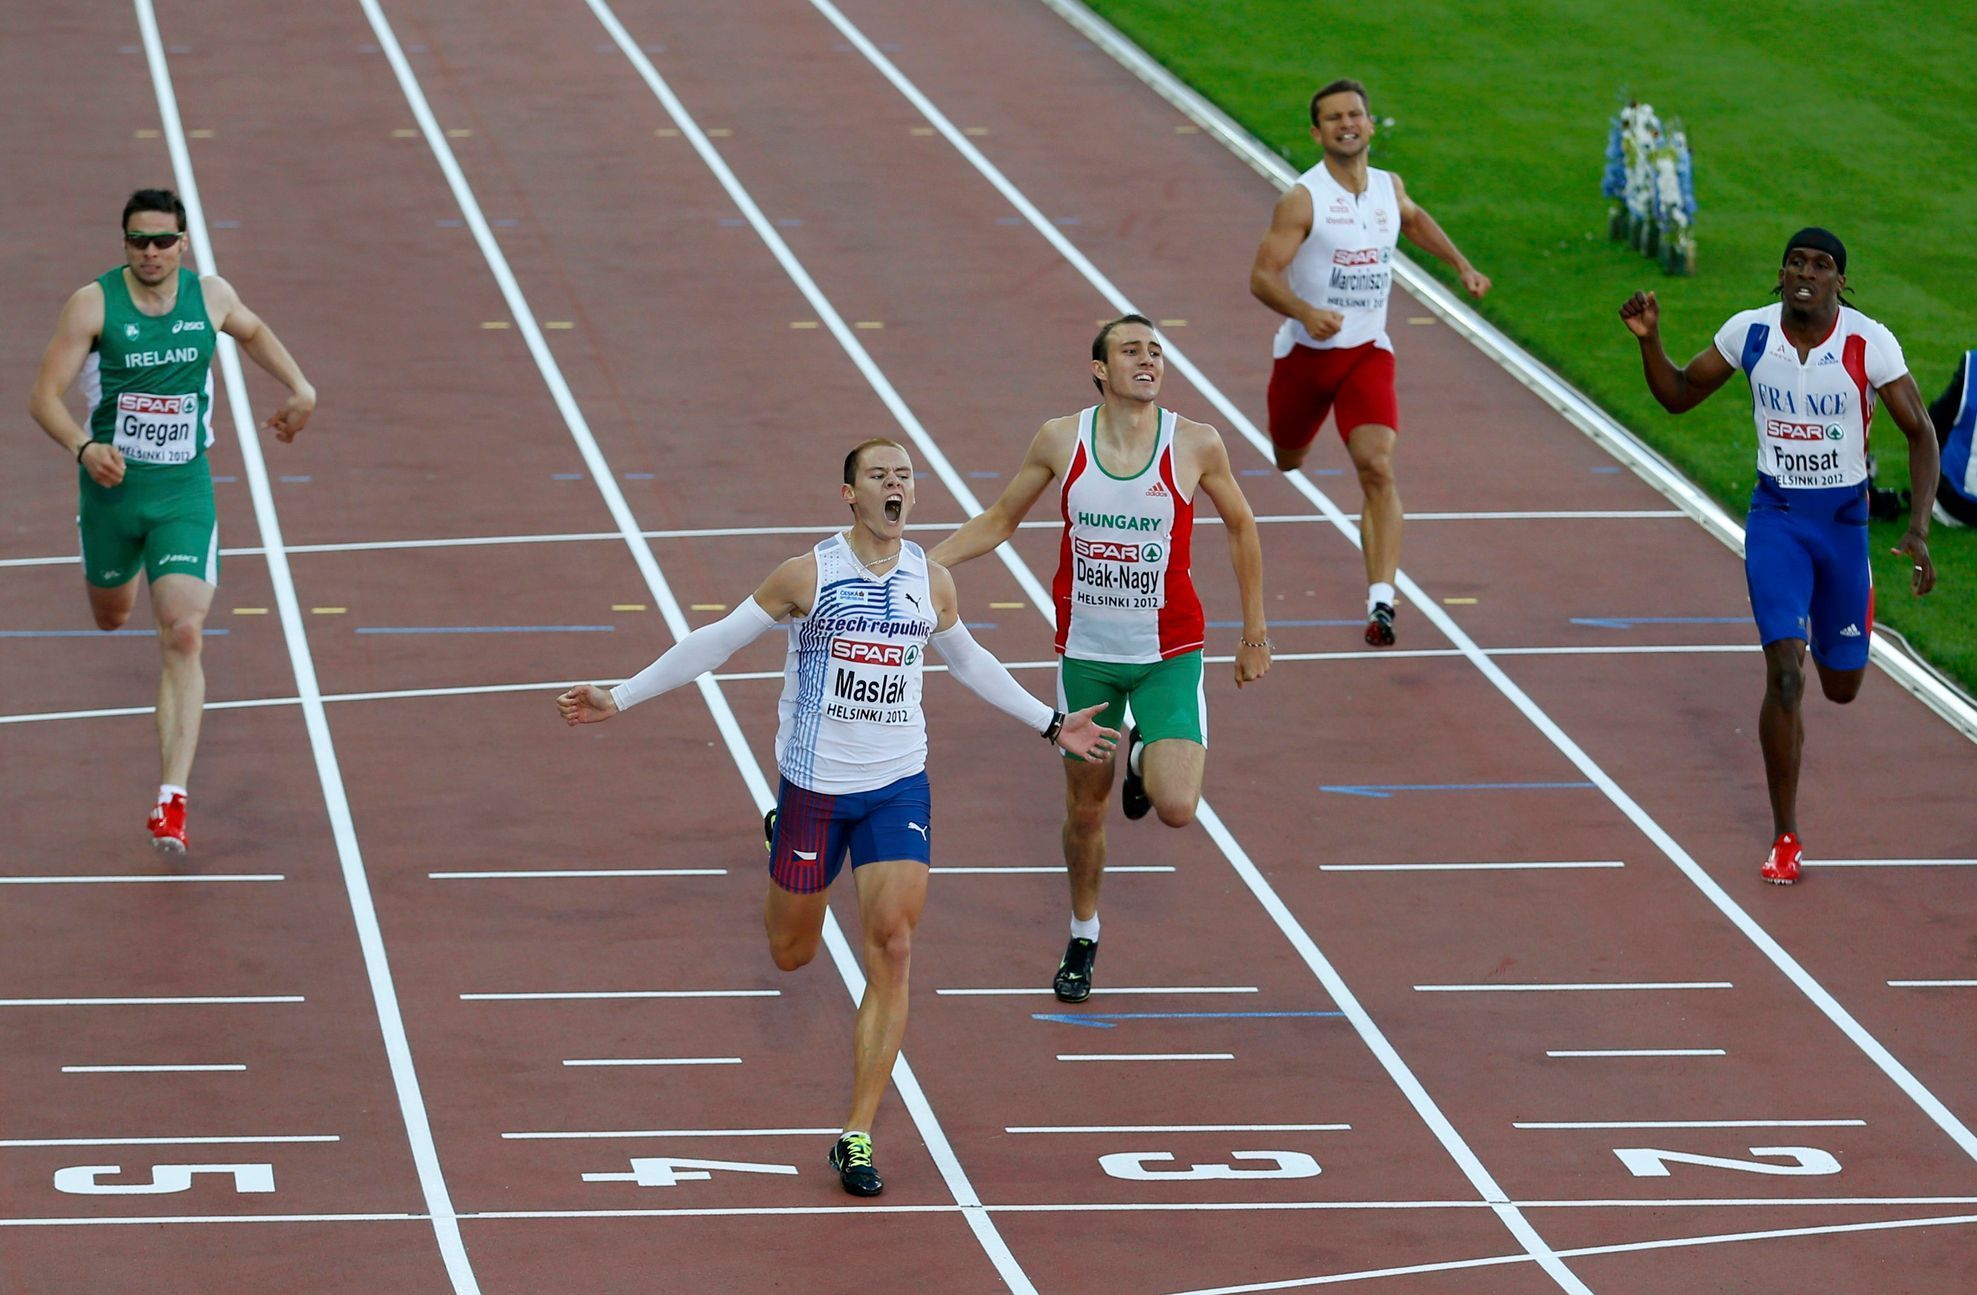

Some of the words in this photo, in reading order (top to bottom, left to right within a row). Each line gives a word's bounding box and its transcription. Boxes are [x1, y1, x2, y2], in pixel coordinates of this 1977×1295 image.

[1327, 297, 1370, 308] HELSINKI
[125, 347, 199, 368] IRELAND
[121, 395, 179, 413] SPAR
[1757, 382, 1847, 416] FRANCE
[123, 415, 189, 447] Gregan
[1767, 421, 1823, 439] SPAR
[117, 445, 165, 462] HELSINKI
[169, 450, 191, 462] 2012
[1774, 445, 1839, 472] Fonsat
[1776, 474, 1818, 486] ELSINKI
[1821, 473, 1844, 486] 2012
[1078, 511, 1162, 531] HUNGARY
[1076, 539, 1138, 560] SPAR
[1077, 557, 1160, 595] Deák-Nagy
[1077, 591, 1130, 607] HELSINKI
[1133, 597, 1158, 608] 2012
[817, 615, 868, 634] czech
[833, 640, 901, 665] SPAR
[834, 667, 907, 704] Maslák
[826, 703, 883, 722] HELSINKI
[886, 709, 909, 723] 2012
[1098, 1150, 1322, 1180] 3
[1612, 1145, 1842, 1177] 2
[53, 1163, 276, 1194] 5
[581, 1157, 799, 1187] 4
